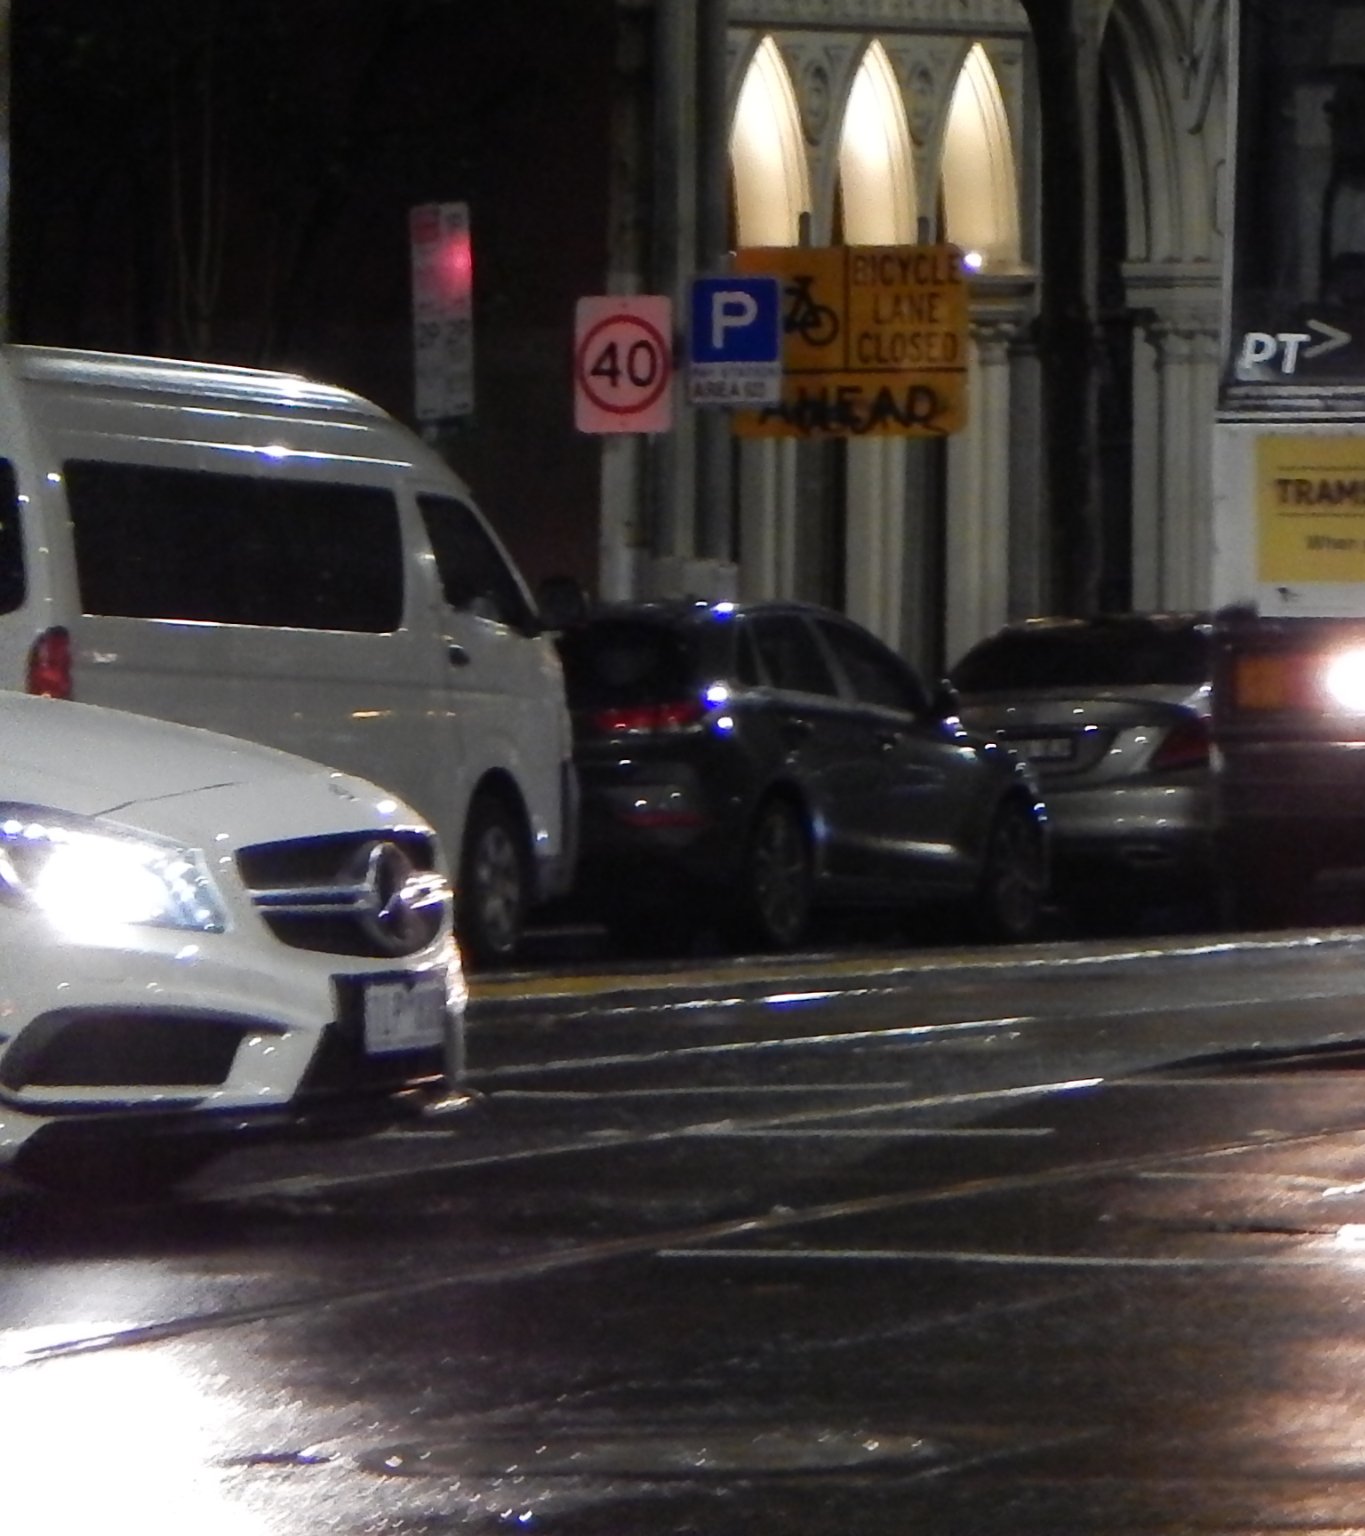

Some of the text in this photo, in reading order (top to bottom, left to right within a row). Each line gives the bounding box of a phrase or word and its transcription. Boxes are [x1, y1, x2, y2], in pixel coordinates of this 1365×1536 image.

[851, 253, 961, 286] BICYCLE
[711, 291, 758, 350] P
[872, 292, 940, 325] LANE
[590, 340, 658, 388] 40
[857, 332, 959, 364] CLOSED
[1306, 535, 1357, 551] When
